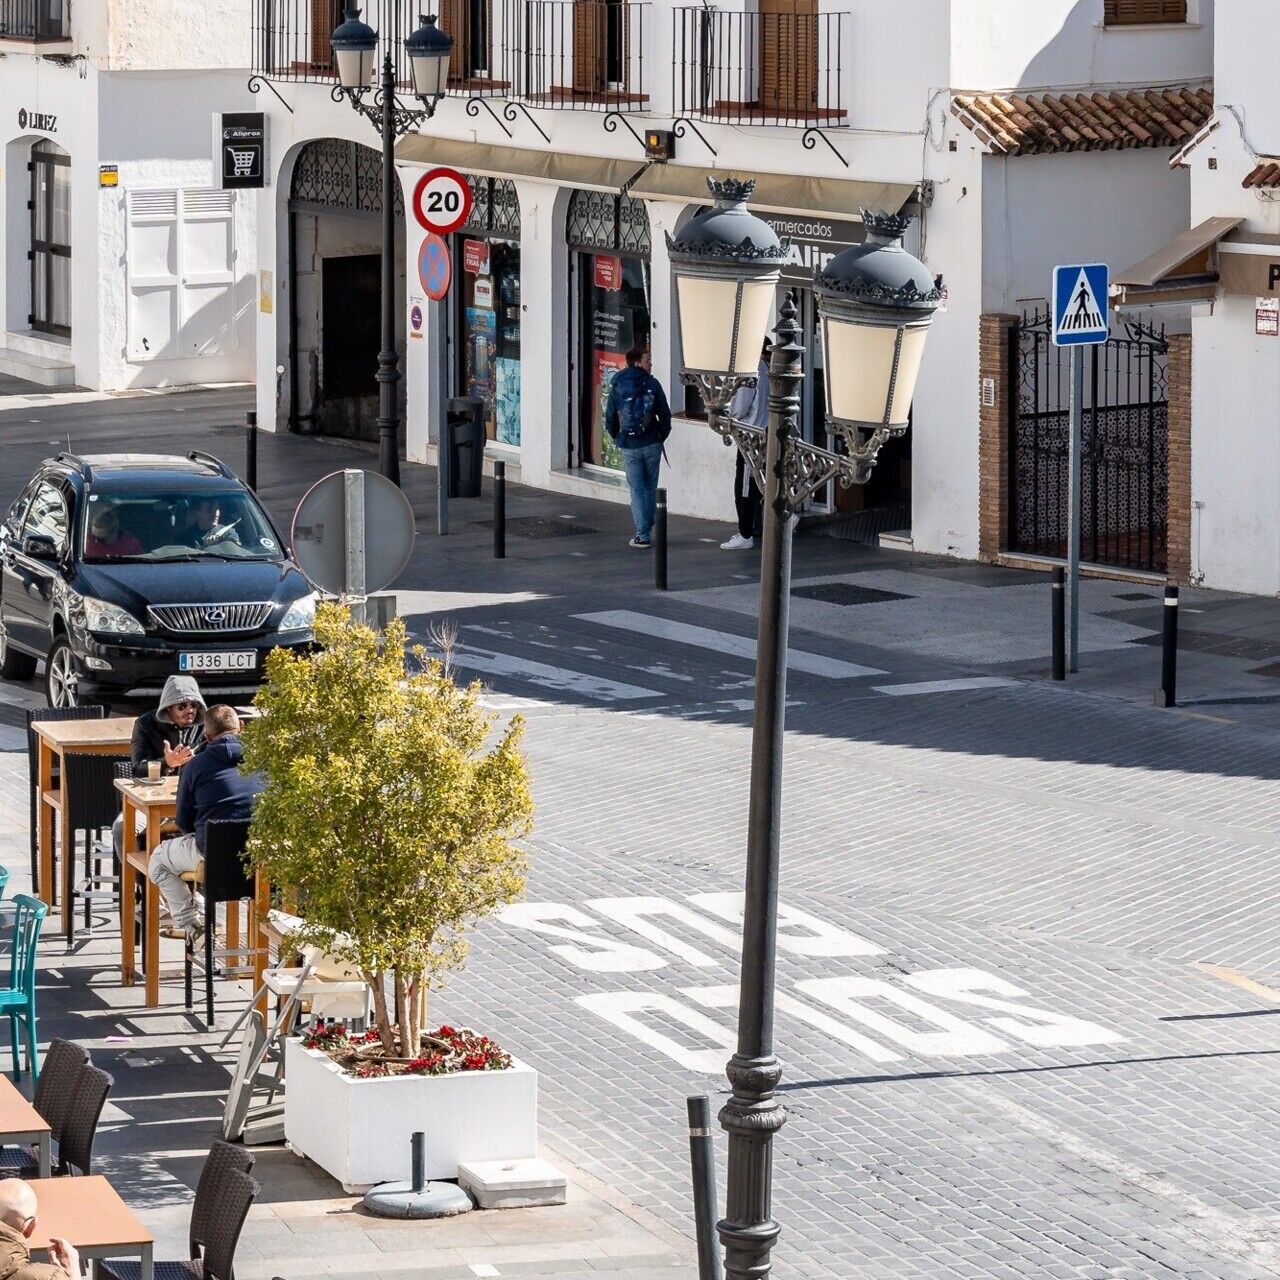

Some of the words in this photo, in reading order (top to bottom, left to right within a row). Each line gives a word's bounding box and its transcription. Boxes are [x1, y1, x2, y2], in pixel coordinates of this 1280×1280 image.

[29, 112, 57, 132] LIREZ
[427, 191, 460, 213] 20
[766, 220, 832, 237] ermercados
[189, 654, 222, 668] 1336
[228, 654, 254, 667] LCT
[493, 890, 893, 974] BUS
